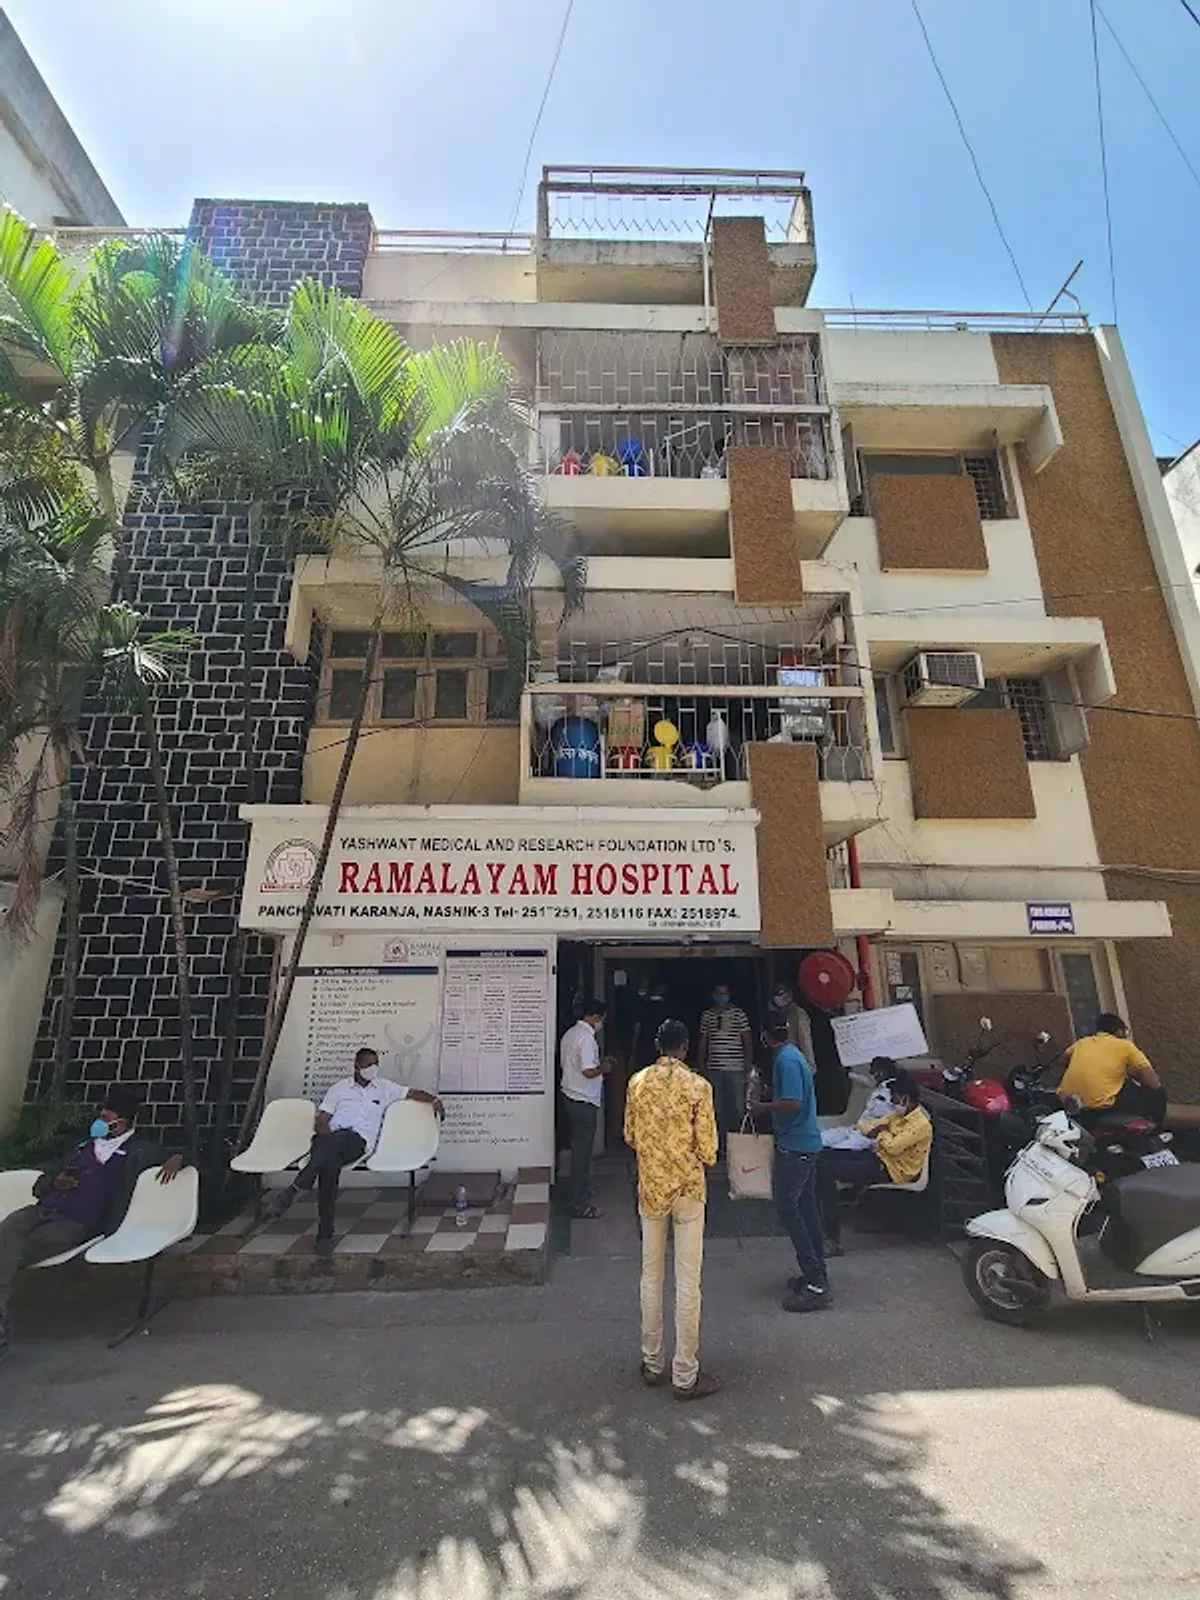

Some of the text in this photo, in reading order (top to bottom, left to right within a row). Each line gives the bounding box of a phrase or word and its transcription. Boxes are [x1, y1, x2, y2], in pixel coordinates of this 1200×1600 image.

[340, 837, 417, 851] YASHWANT
[420, 838, 481, 851] MEDICAL
[485, 838, 515, 851] AND
[518, 838, 594, 852] RESEARCH
[598, 838, 687, 852] FOUNDATION
[338, 861, 739, 895] RAMALAYAM HOSPITAL
[258, 905, 346, 917] PANCHVATI
[350, 905, 419, 918] KARANJA,
[424, 905, 489, 917] NASHIK-3
